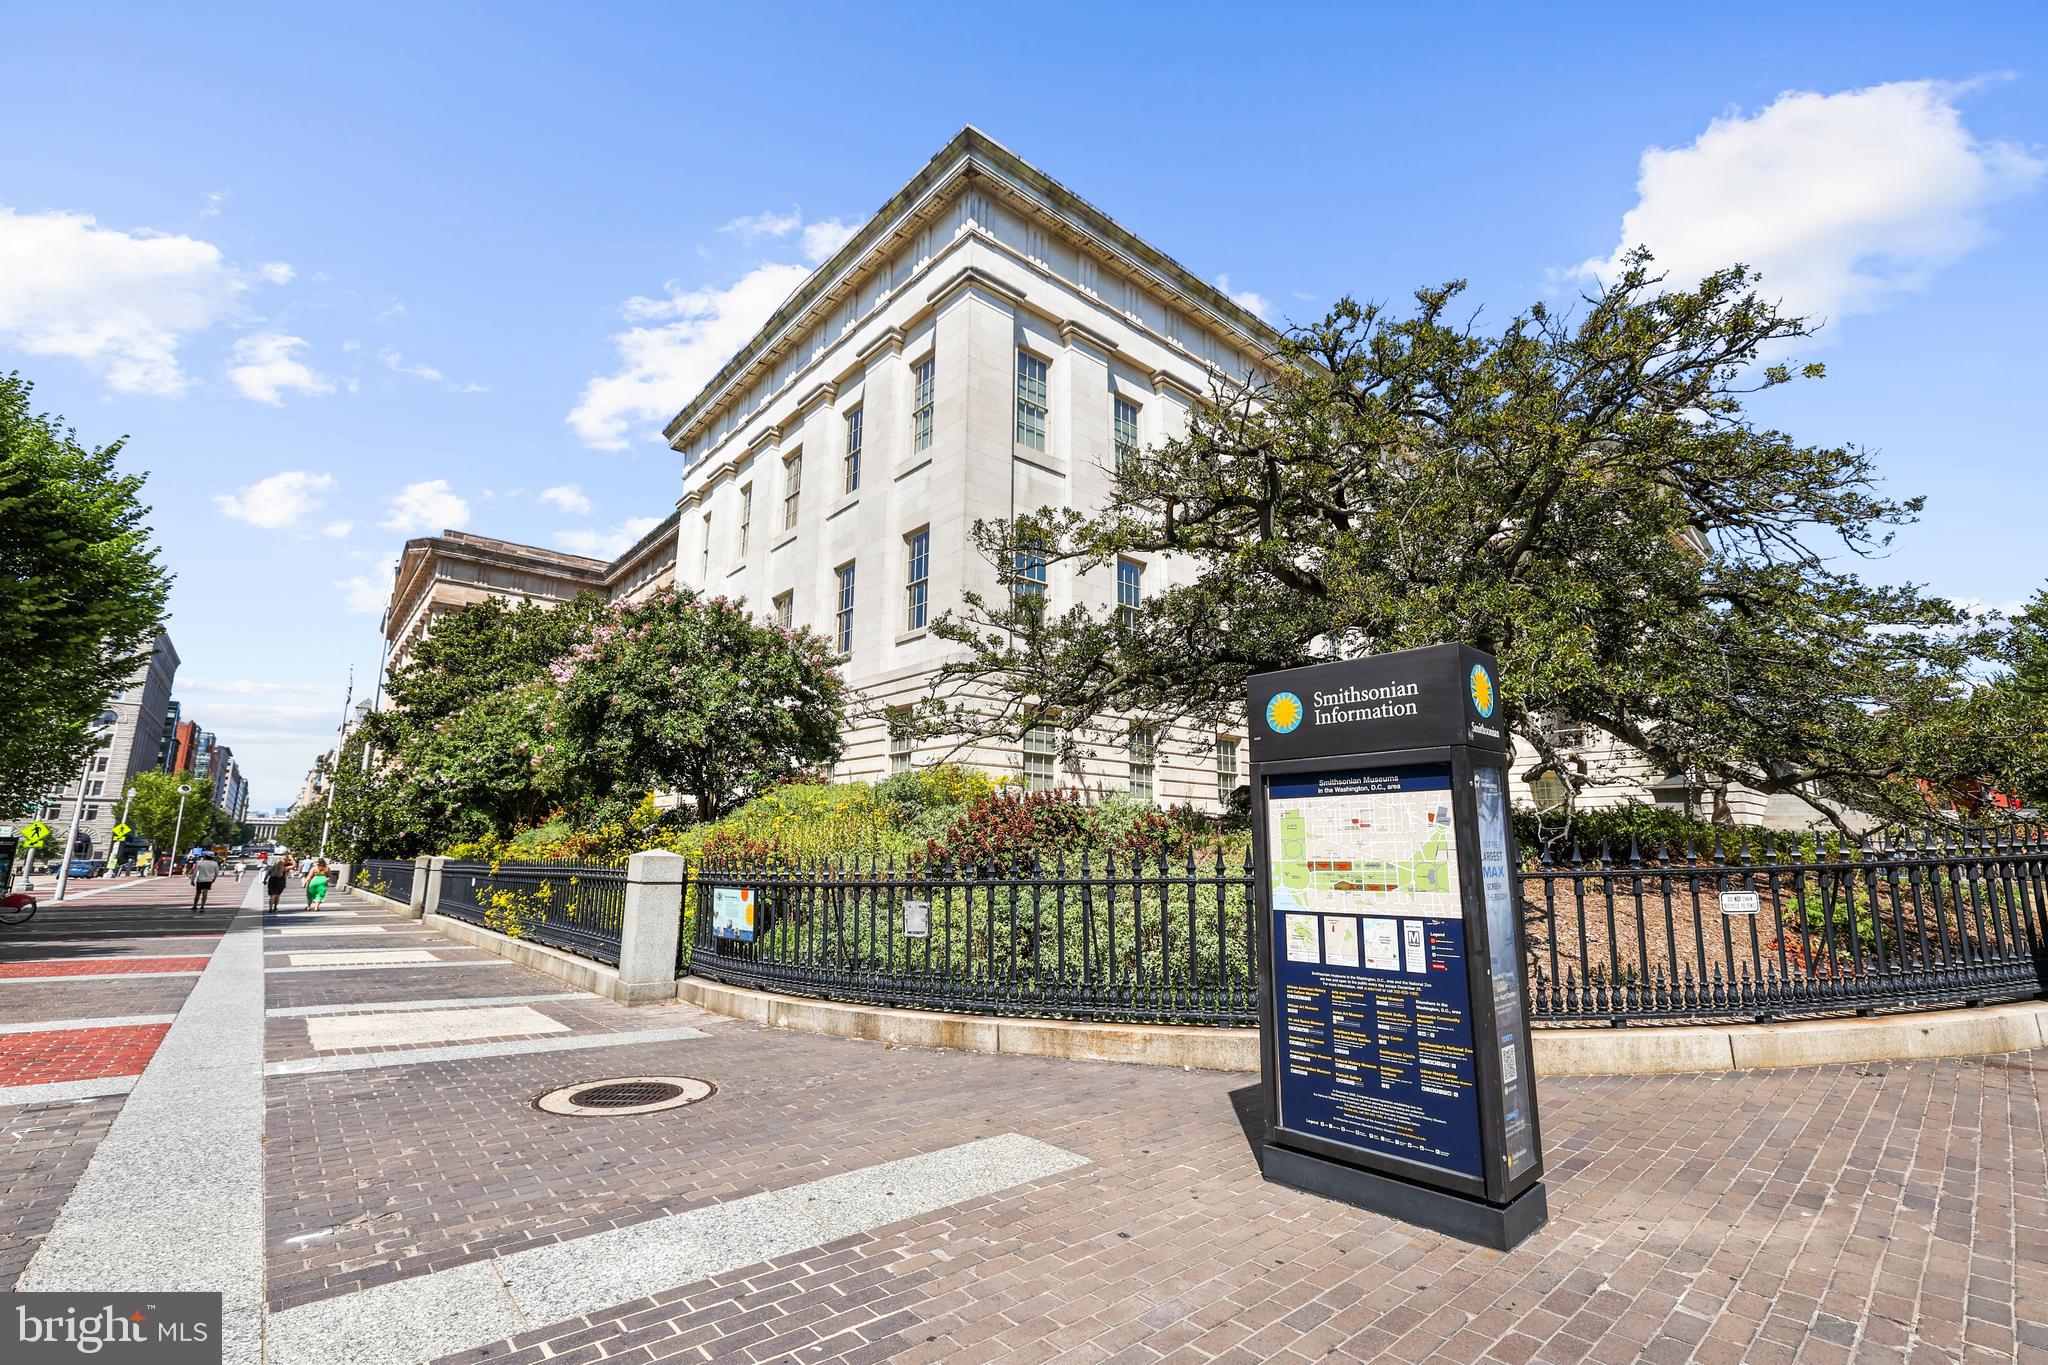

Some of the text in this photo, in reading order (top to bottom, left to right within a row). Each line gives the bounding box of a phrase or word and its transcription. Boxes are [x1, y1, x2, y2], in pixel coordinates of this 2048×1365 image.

[1313, 681, 1419, 708] Smithsonian
[1315, 701, 1417, 725] Information
[1471, 722, 1500, 738] Smithsonian
[1319, 778, 1361, 786] Smithsonian
[1334, 785, 1369, 793] Washington,
[1482, 851, 1502, 861] ARGEST
